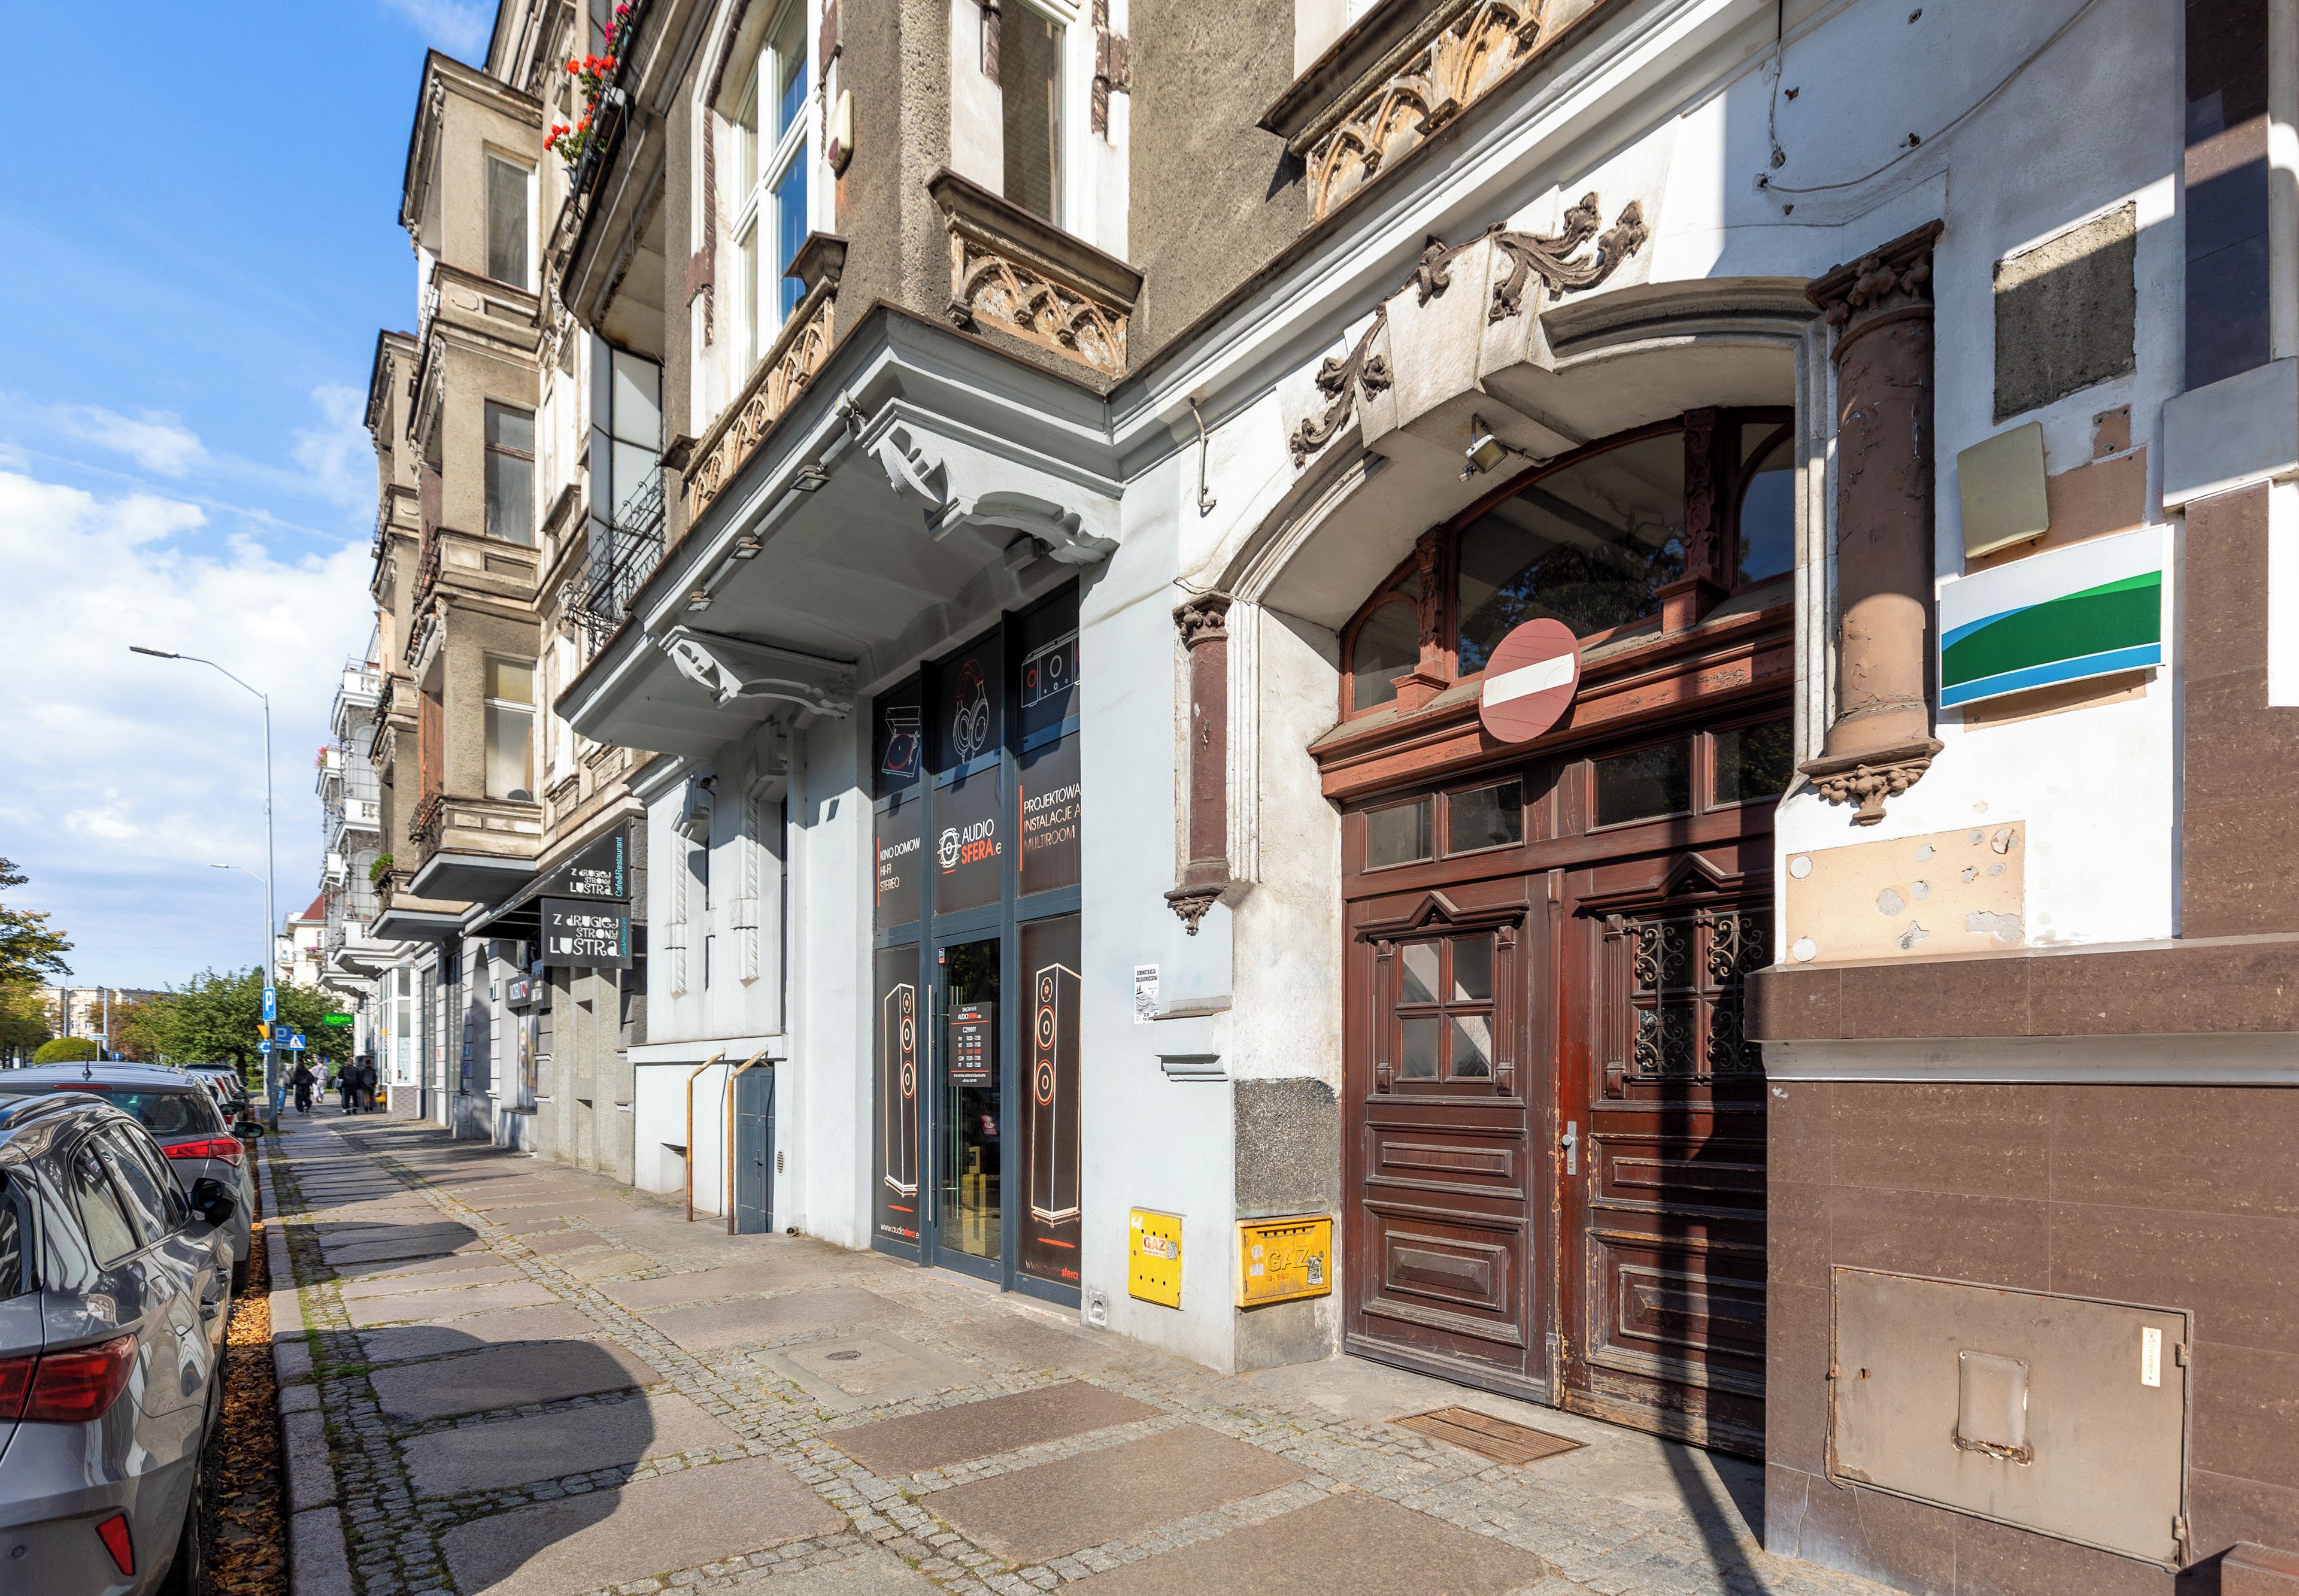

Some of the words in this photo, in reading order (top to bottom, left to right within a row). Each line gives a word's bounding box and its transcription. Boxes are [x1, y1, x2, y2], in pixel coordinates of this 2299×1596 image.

[1024, 806, 1072, 834] INSTALACJE
[962, 818, 994, 842] AUDIO
[1024, 824, 1075, 852] MULTIROOM
[879, 848, 894, 862] KINO
[571, 868, 577, 876] Z
[615, 836, 623, 897] Cafe&Restaurant
[879, 863, 891, 876] HI-FI
[879, 876, 900, 893] STEREO
[553, 914, 563, 925] Z
[265, 991, 273, 1011] P
[275, 1028, 287, 1040] P
[1144, 1237, 1166, 1251] GAZ
[1267, 1246, 1310, 1272] GAZ
